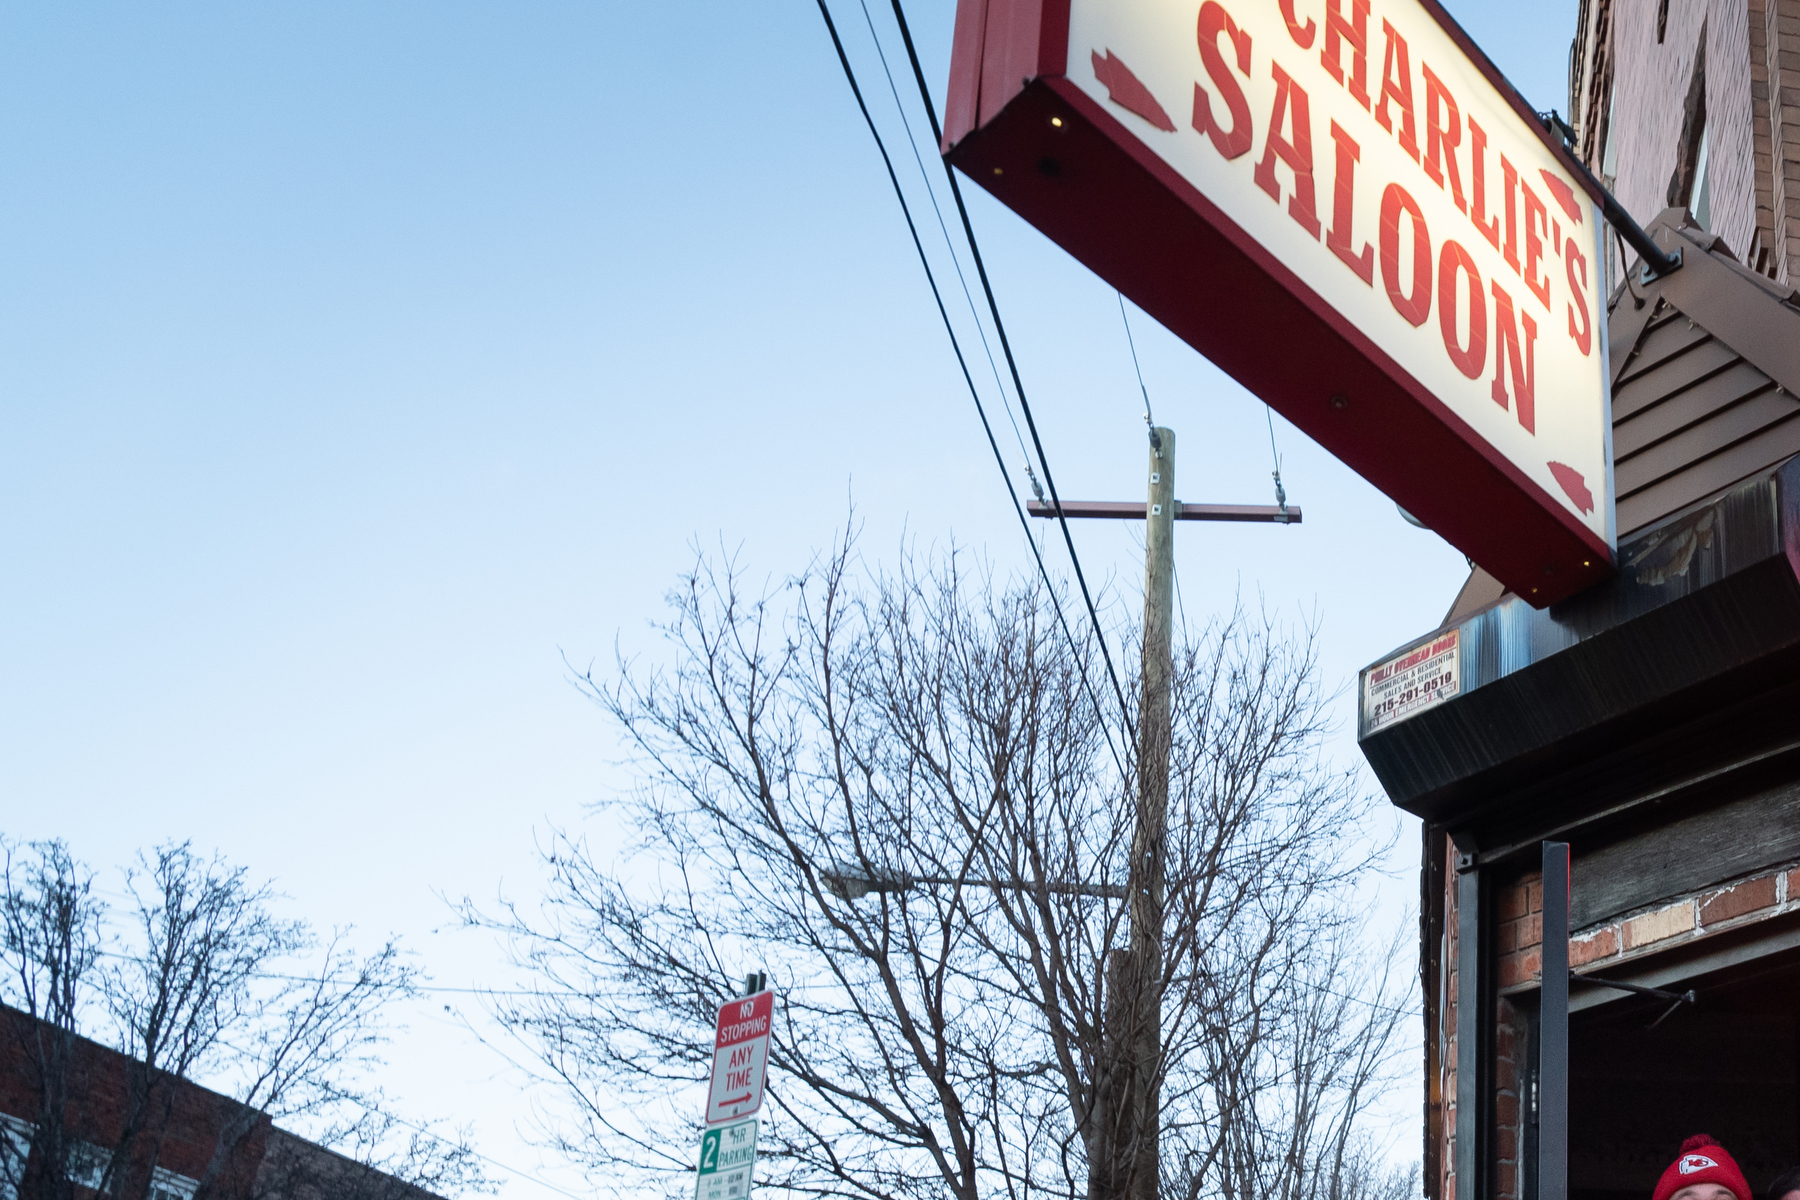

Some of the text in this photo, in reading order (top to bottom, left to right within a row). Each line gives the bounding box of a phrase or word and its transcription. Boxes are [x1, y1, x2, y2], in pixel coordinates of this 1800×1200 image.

[1192, 1, 1537, 436] SALOON
[1371, 651, 1454, 697] COMMERCIAL & RESIDENTIAL
[1383, 667, 1441, 700] SALES AND SERVICE
[1374, 671, 1452, 717] 215-291-0519
[739, 1001, 755, 1019] NO
[720, 1015, 767, 1043] STOPPING
[728, 1044, 754, 1069] ANY
[726, 1066, 753, 1092] TIME
[703, 1127, 746, 1169] 2 HR
[718, 1145, 753, 1167] PARKING
